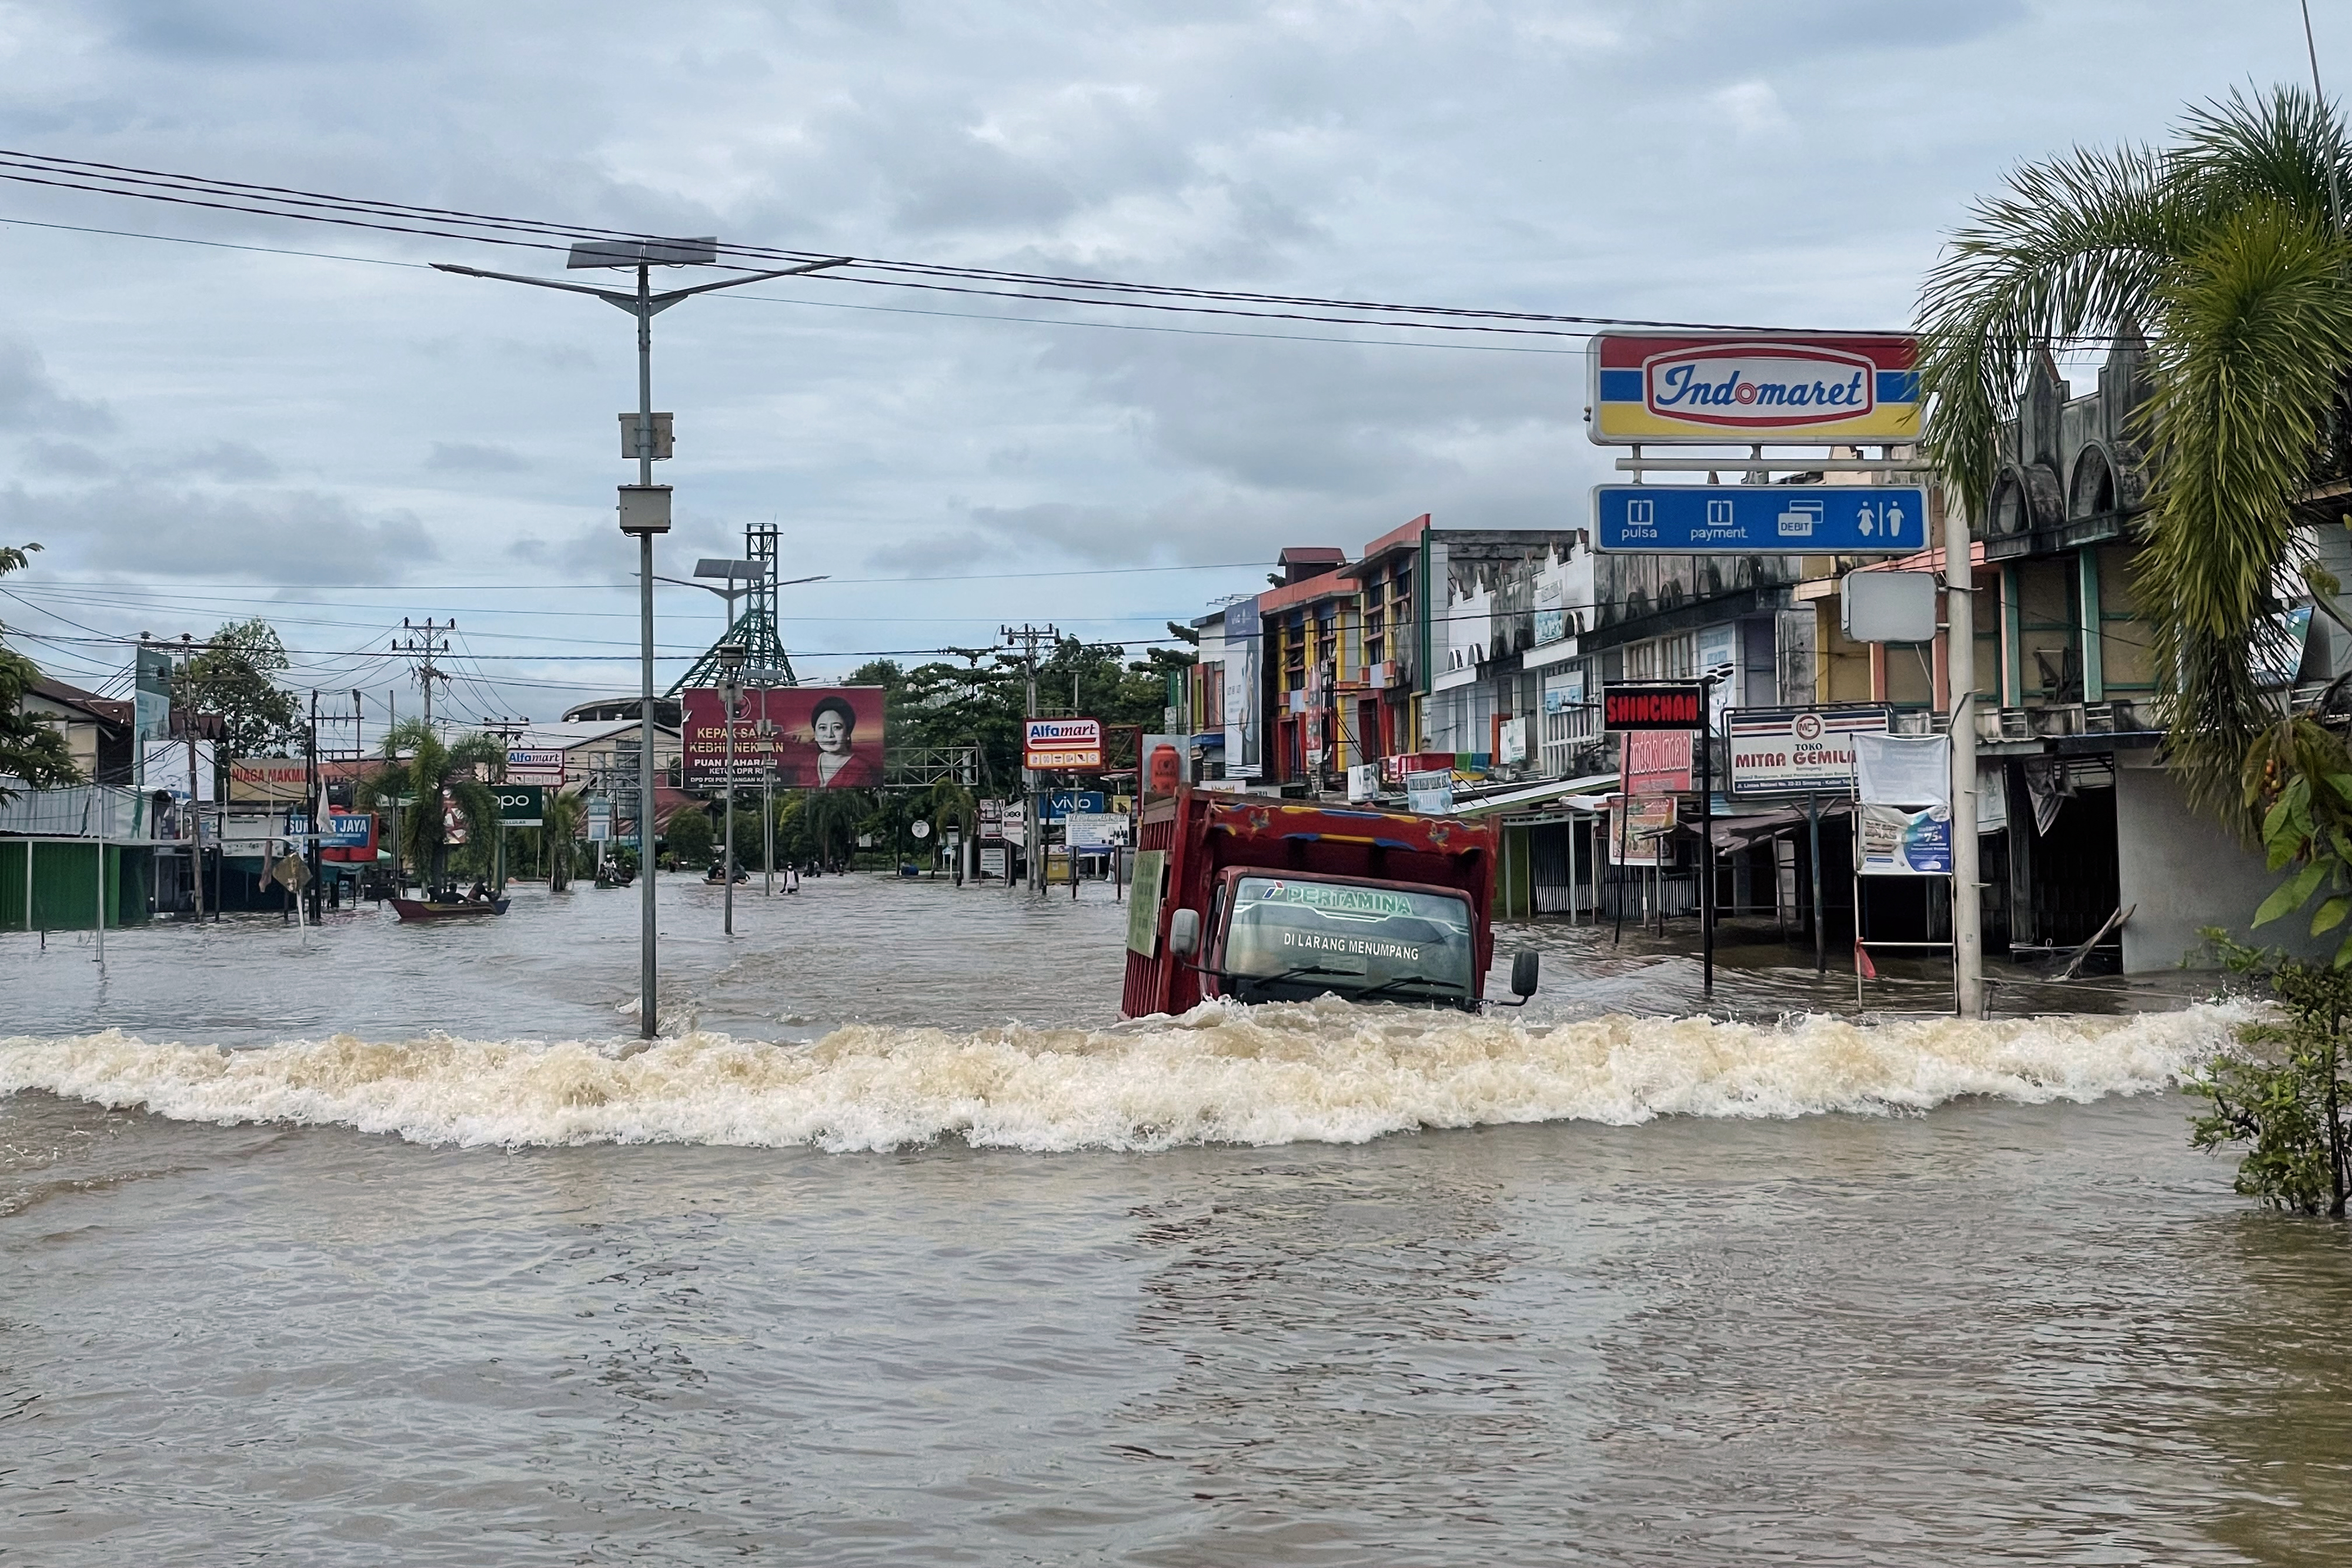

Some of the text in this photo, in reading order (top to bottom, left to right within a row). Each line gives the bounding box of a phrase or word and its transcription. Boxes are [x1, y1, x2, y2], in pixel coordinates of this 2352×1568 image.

[1656, 364, 1863, 406] Indomaret
[1622, 521, 1809, 540] pulsa payment DEBIT
[1606, 695, 1698, 723] SHINCHAN
[1031, 724, 1096, 737] Alfamart
[689, 741, 784, 753] KEBHINEKN
[1795, 743, 1823, 751] TOKO
[509, 751, 560, 763] Alfamart
[1735, 753, 1786, 768] MITRA
[232, 768, 308, 783] NIAGA MAKMU
[340, 820, 367, 833] JAYA
[1287, 885, 1413, 915] PERTAMINA
[1284, 932, 1295, 946] DI
[1298, 934, 1345, 952] LARANG
[1348, 940, 1419, 961] MENUMPANG
